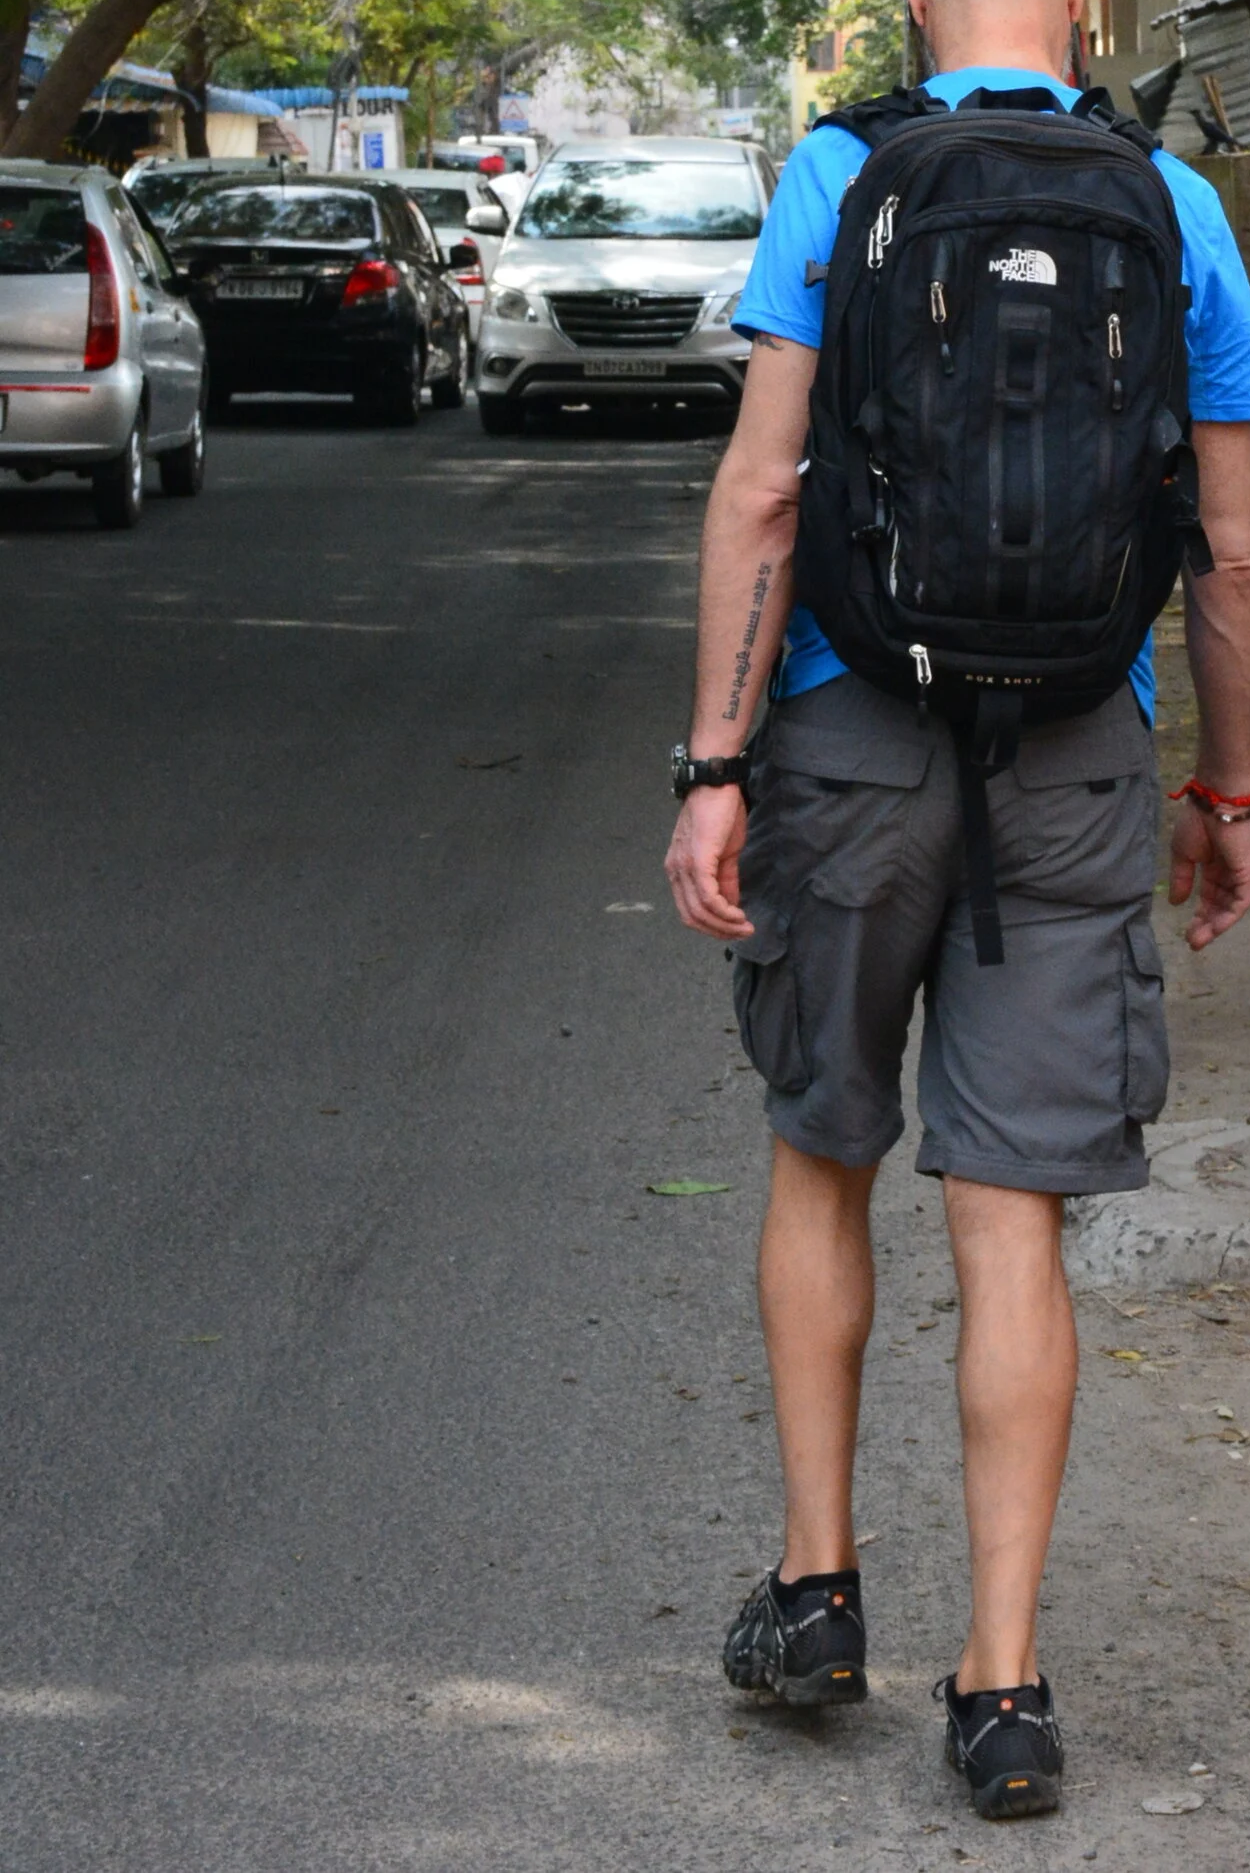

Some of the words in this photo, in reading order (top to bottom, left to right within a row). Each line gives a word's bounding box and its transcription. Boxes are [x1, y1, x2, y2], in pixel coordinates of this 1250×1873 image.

[1009, 248, 1036, 262] THE
[989, 259, 1035, 272] NORTH
[1002, 270, 1036, 282] FACE
